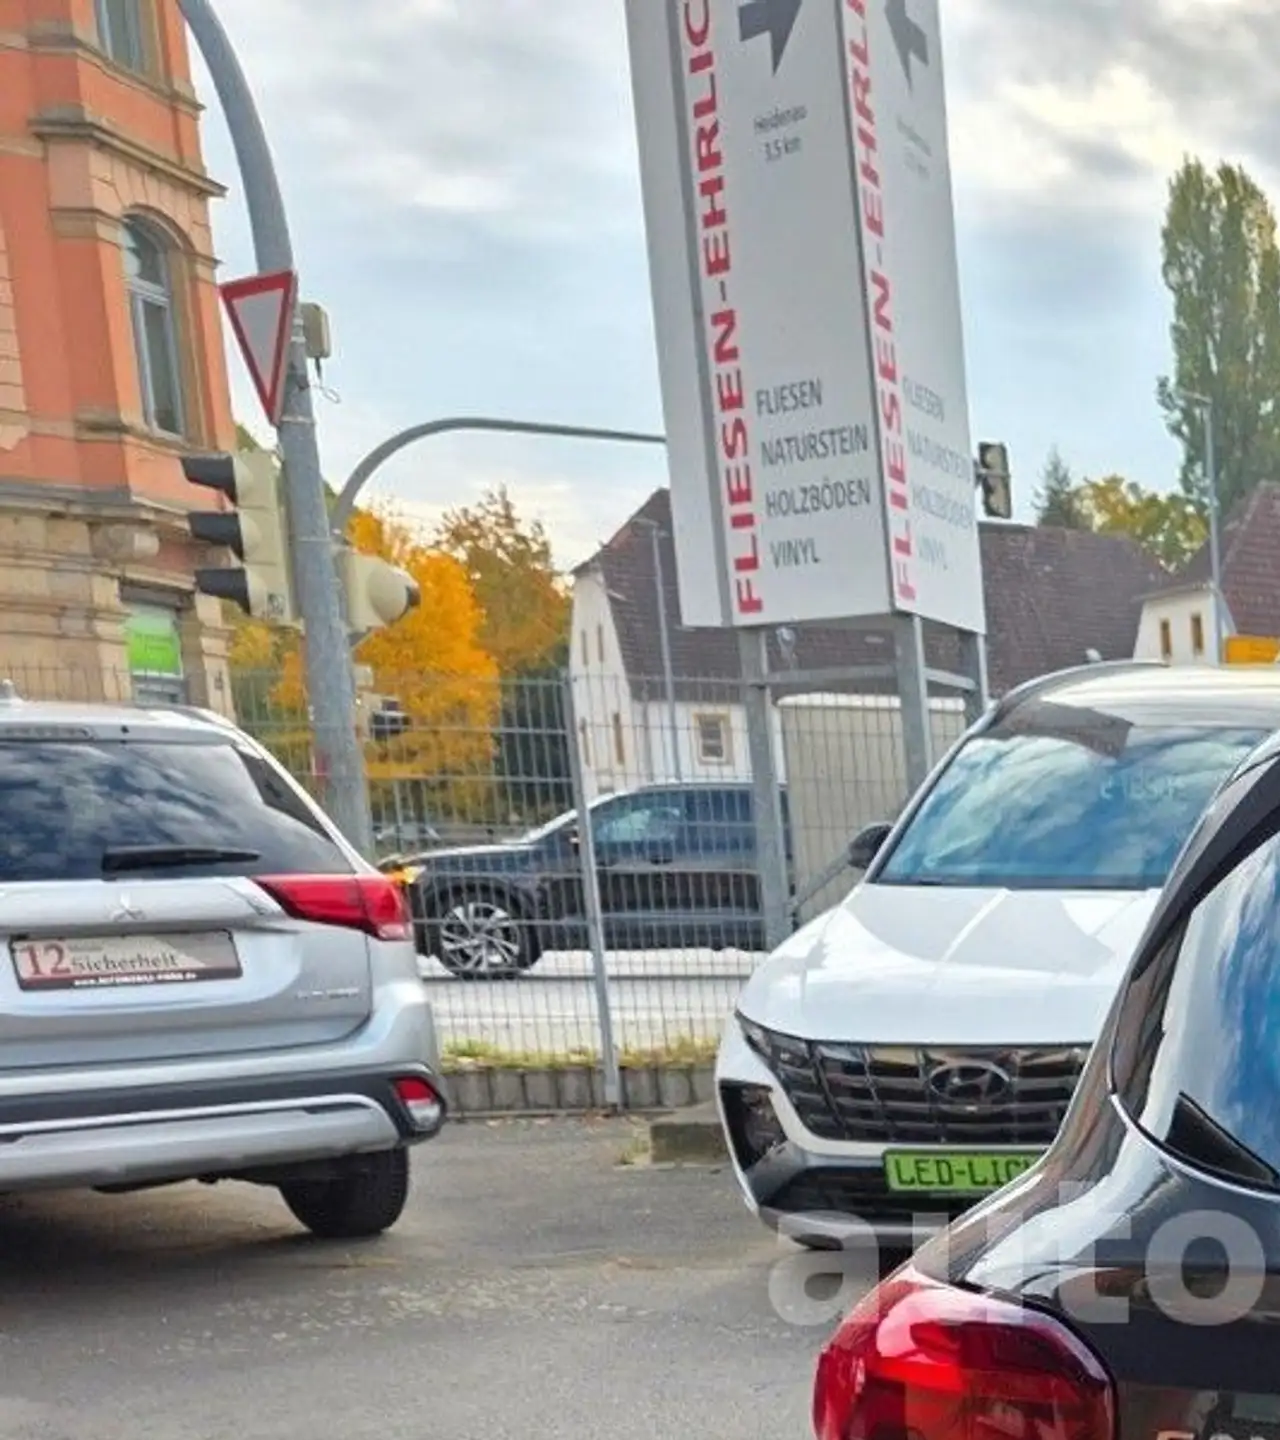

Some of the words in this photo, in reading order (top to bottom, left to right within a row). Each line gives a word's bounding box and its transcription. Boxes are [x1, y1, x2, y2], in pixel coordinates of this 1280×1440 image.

[756, 378, 823, 416] FLIESEN
[761, 423, 869, 467] NATURSTEIN
[765, 477, 871, 518] HOLZBÖDEN
[769, 538, 821, 569] VINYL
[22, 943, 71, 976] 12
[894, 1157, 1032, 1187] LED-LIC
